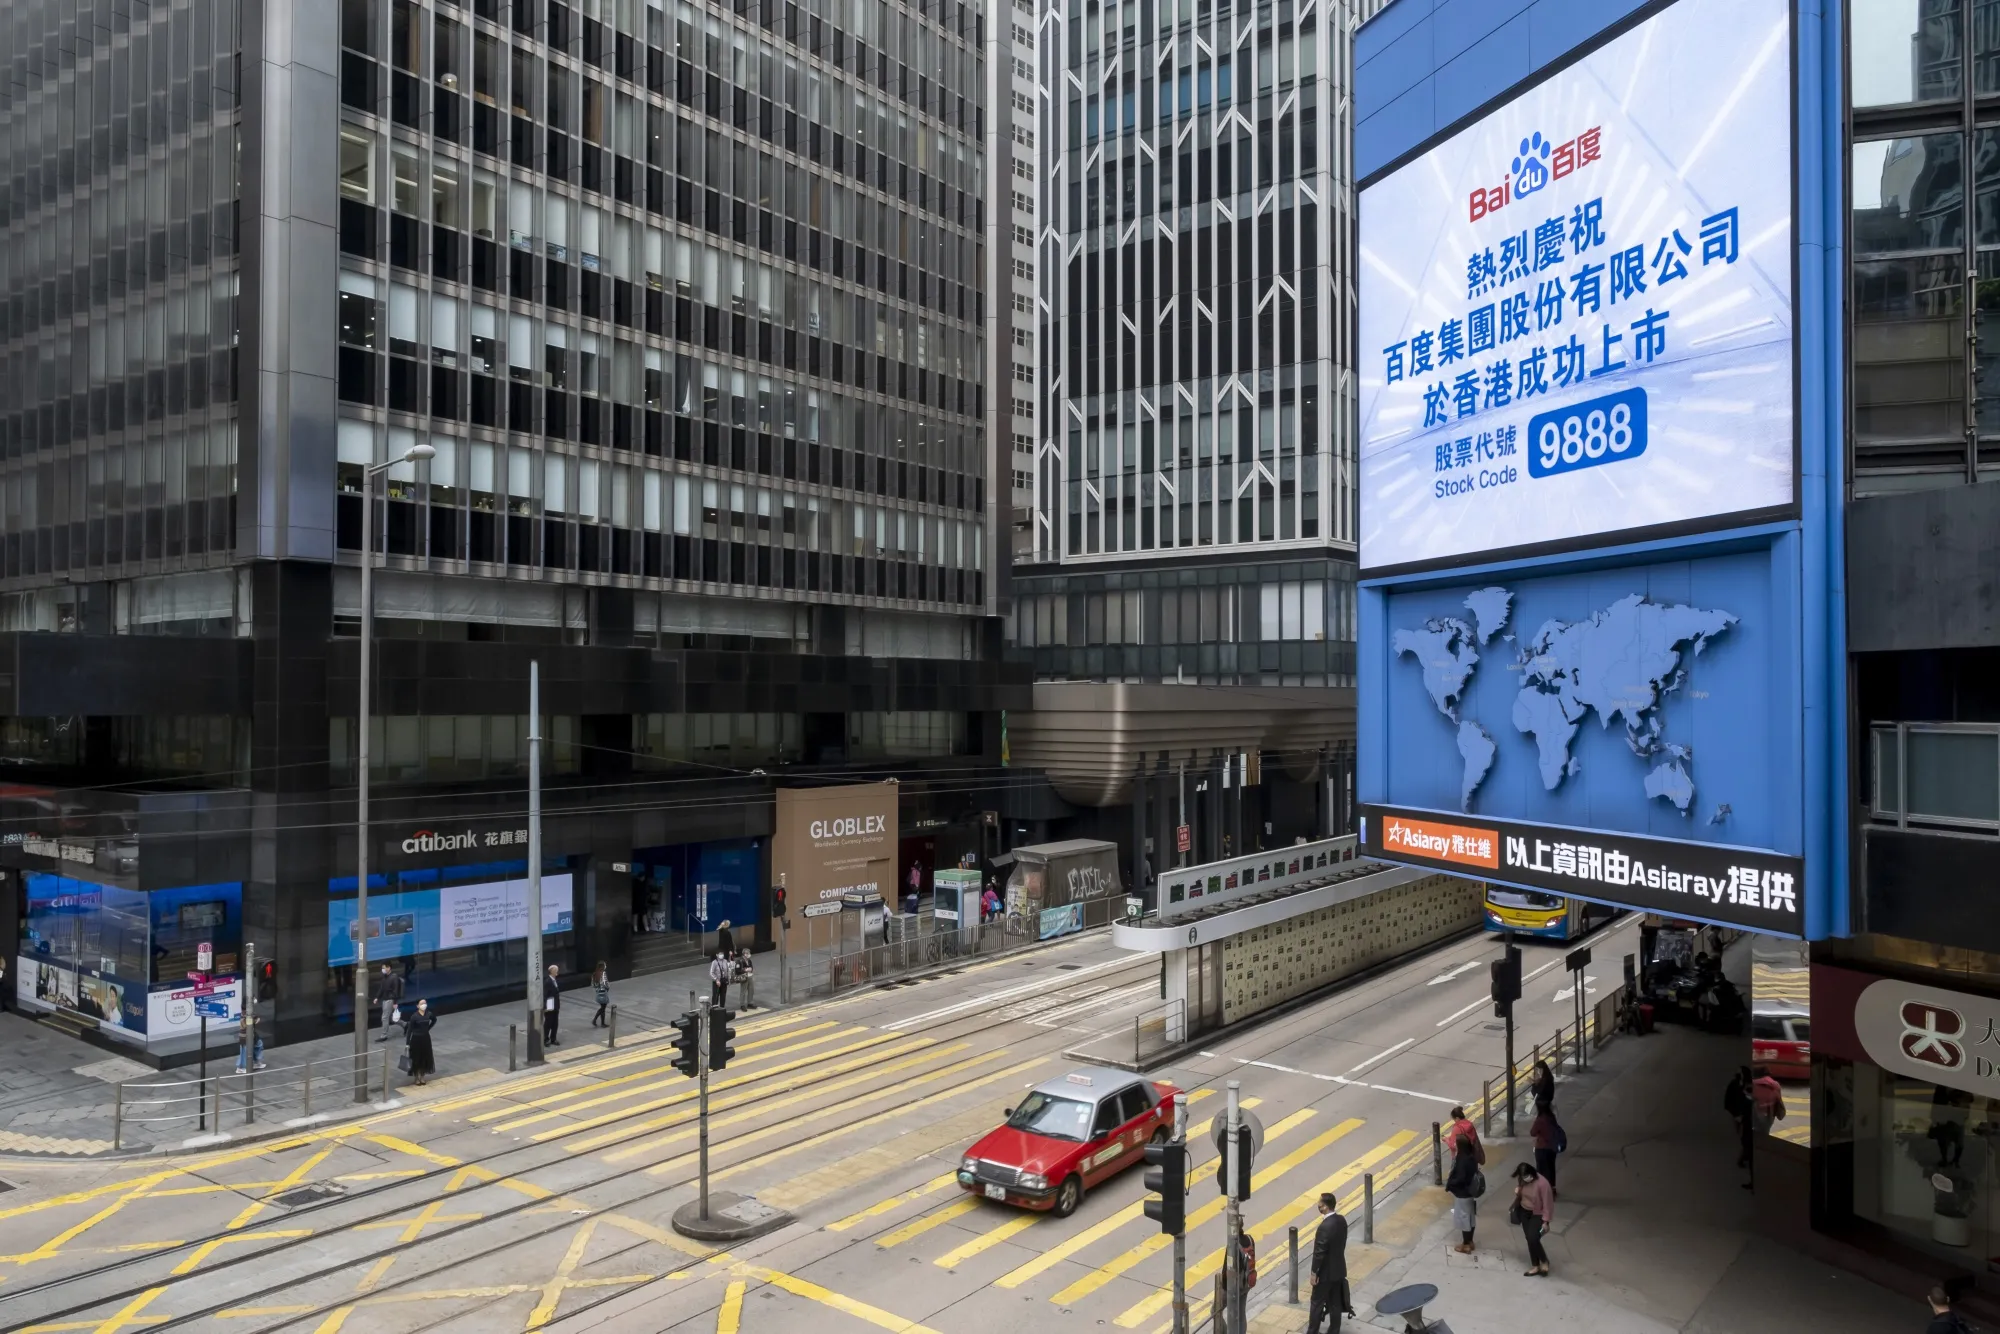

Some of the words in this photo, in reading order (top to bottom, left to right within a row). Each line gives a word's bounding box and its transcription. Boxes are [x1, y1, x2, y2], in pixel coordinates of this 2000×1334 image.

[1551, 125, 1602, 182] 百度
[1466, 197, 1606, 300] 熱烈慶祝
[1382, 206, 1739, 386] 百度集團股份有限公司
[1422, 307, 1670, 428] 於香港成功上市
[1434, 424, 1517, 473] 股票代號
[1539, 402, 1633, 470] 9888
[1435, 475, 1475, 498] Stock
[1479, 465, 1517, 489] Code
[401, 829, 478, 854] citibank
[484, 828, 542, 847] 花旗銀
[810, 815, 885, 839] GLOBLEX
[1402, 826, 1450, 857] Asiaray
[1451, 834, 1492, 859] 雅仕維
